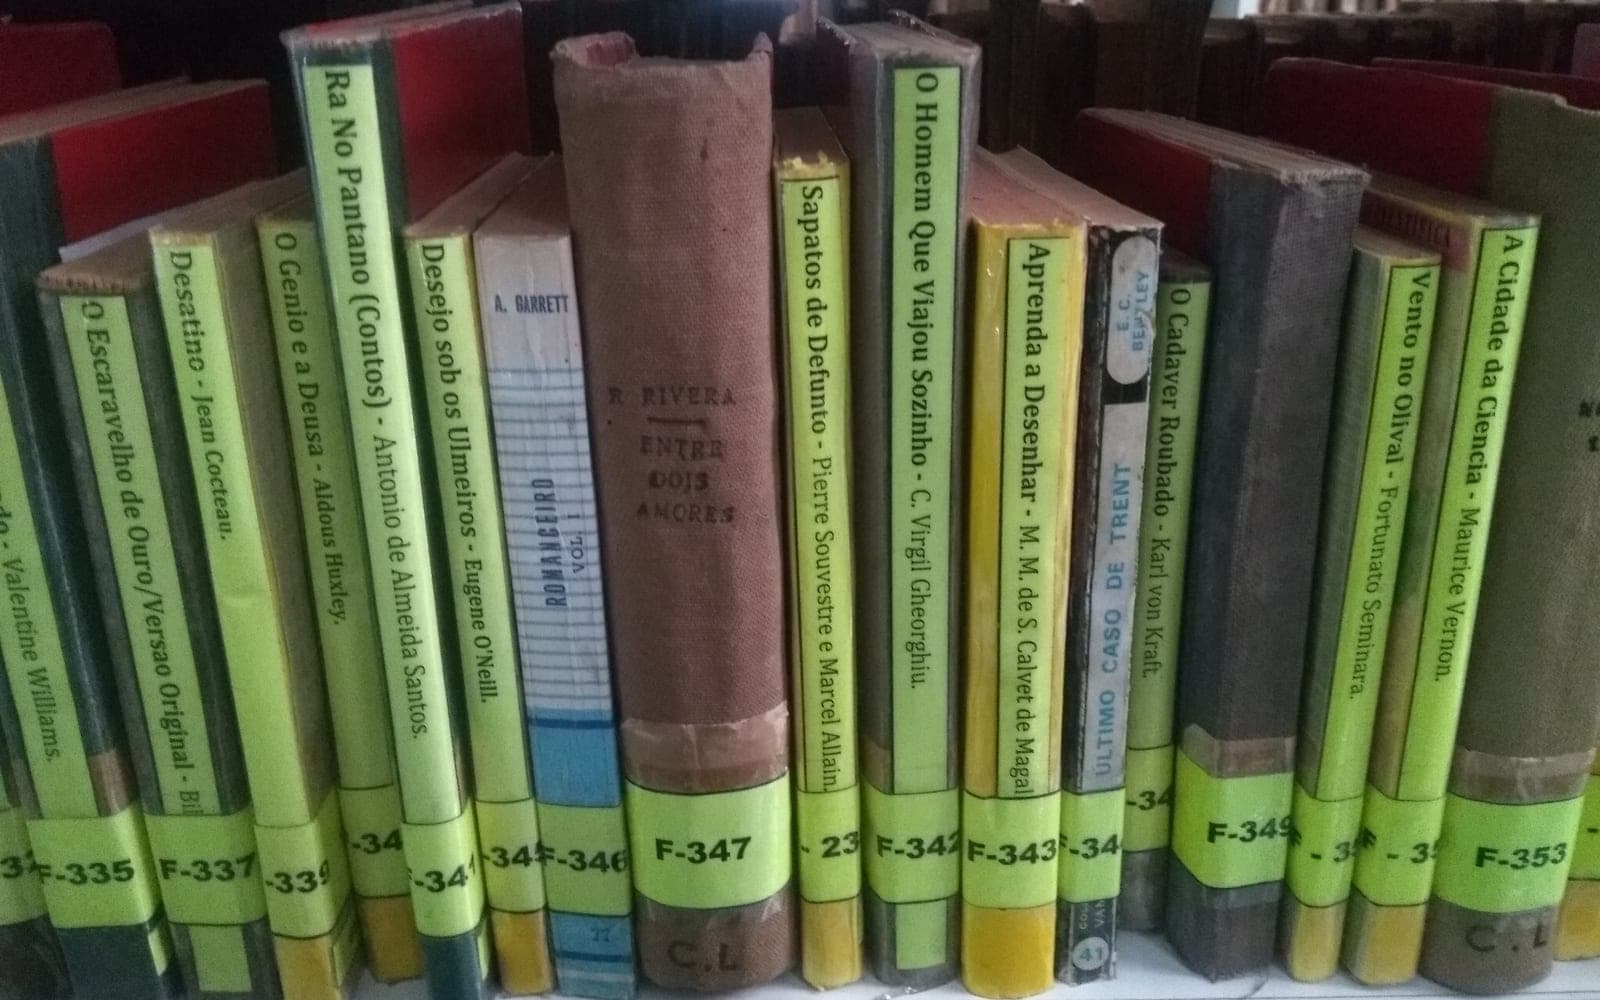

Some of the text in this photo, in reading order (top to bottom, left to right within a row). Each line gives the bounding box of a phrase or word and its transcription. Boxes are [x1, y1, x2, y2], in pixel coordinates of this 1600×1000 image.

[325, 71, 349, 109] Ra
[916, 72, 939, 93] O
[331, 117, 358, 158] No
[914, 104, 939, 212] Homem
[275, 233, 297, 250] O
[338, 166, 371, 286] Pantano
[797, 186, 824, 290] Sapatos
[908, 221, 936, 272] Que
[1503, 234, 1524, 253] A
[82, 302, 105, 320] O
[279, 251, 308, 333] Genio
[422, 245, 453, 332] Desejo
[495, 294, 570, 313] A. GARRETT
[806, 297, 828, 328] de
[907, 280, 936, 361] Viajou
[1022, 243, 1051, 357] Aprenda
[1170, 288, 1192, 305] O
[1401, 272, 1431, 348] Vento
[1487, 261, 1521, 350] Cidade
[170, 251, 206, 373] Desatino
[191, 395, 217, 441] Jean
[291, 338, 307, 353] e
[296, 361, 311, 375] a
[349, 294, 392, 409] (Contos)
[436, 340, 462, 385] sob
[1024, 365, 1043, 377] a
[1161, 313, 1190, 414] Cadaver
[1397, 356, 1416, 386] no
[1482, 358, 1504, 389] da
[86, 329, 136, 485] Escaravelho
[443, 392, 462, 419] os
[641, 386, 737, 406] RIVERA
[808, 335, 830, 435] Defunto
[299, 383, 325, 458] Deusa
[640, 434, 725, 462] ENTRE
[911, 369, 933, 467] Sozinho
[1020, 385, 1046, 502] Desenhar
[1385, 394, 1415, 464] Olival
[1465, 396, 1499, 486] Ciencia
[373, 436, 405, 528] Antonio
[447, 427, 477, 537] Ulmeiros
[813, 457, 832, 523] Pierre
[911, 489, 931, 508] C.
[1154, 416, 1181, 517] Roubado
[118, 489, 144, 520] de
[313, 478, 337, 551] Aldous
[636, 502, 736, 523] AMORES
[1109, 463, 1131, 545] TRENT
[389, 534, 411, 563] de
[531, 478, 568, 607] ROMANCEIRO
[906, 514, 932, 572] Virgil
[1018, 557, 1040, 582] M.
[1019, 526, 1041, 550] M.
[1150, 539, 1171, 578] Karl
[1366, 487, 1399, 595] Fortunato
[1448, 508, 1481, 596] Maurice
[4, 555, 39, 661] Valentine
[128, 525, 172, 677] Ouro/Versao
[463, 559, 486, 630] Eugene
[814, 530, 835, 636] Souvestre
[1018, 587, 1039, 612] de
[1106, 562, 1125, 590] DE
[1146, 584, 1163, 621] von
[391, 569, 424, 660] Almeida
[823, 641, 833, 652] e
[905, 578, 932, 689] Gheorghiu.
[1017, 618, 1038, 634] S.
[1102, 608, 1122, 674] CASO
[819, 659, 841, 726] Marcel
[1016, 640, 1037, 705] Calvet
[160, 681, 196, 770] Original
[1016, 708, 1036, 732] de
[158, 852, 256, 883] F-337
[655, 836, 752, 864] F-347
[967, 839, 1058, 866] F-343
[1475, 842, 1567, 870] F-353
